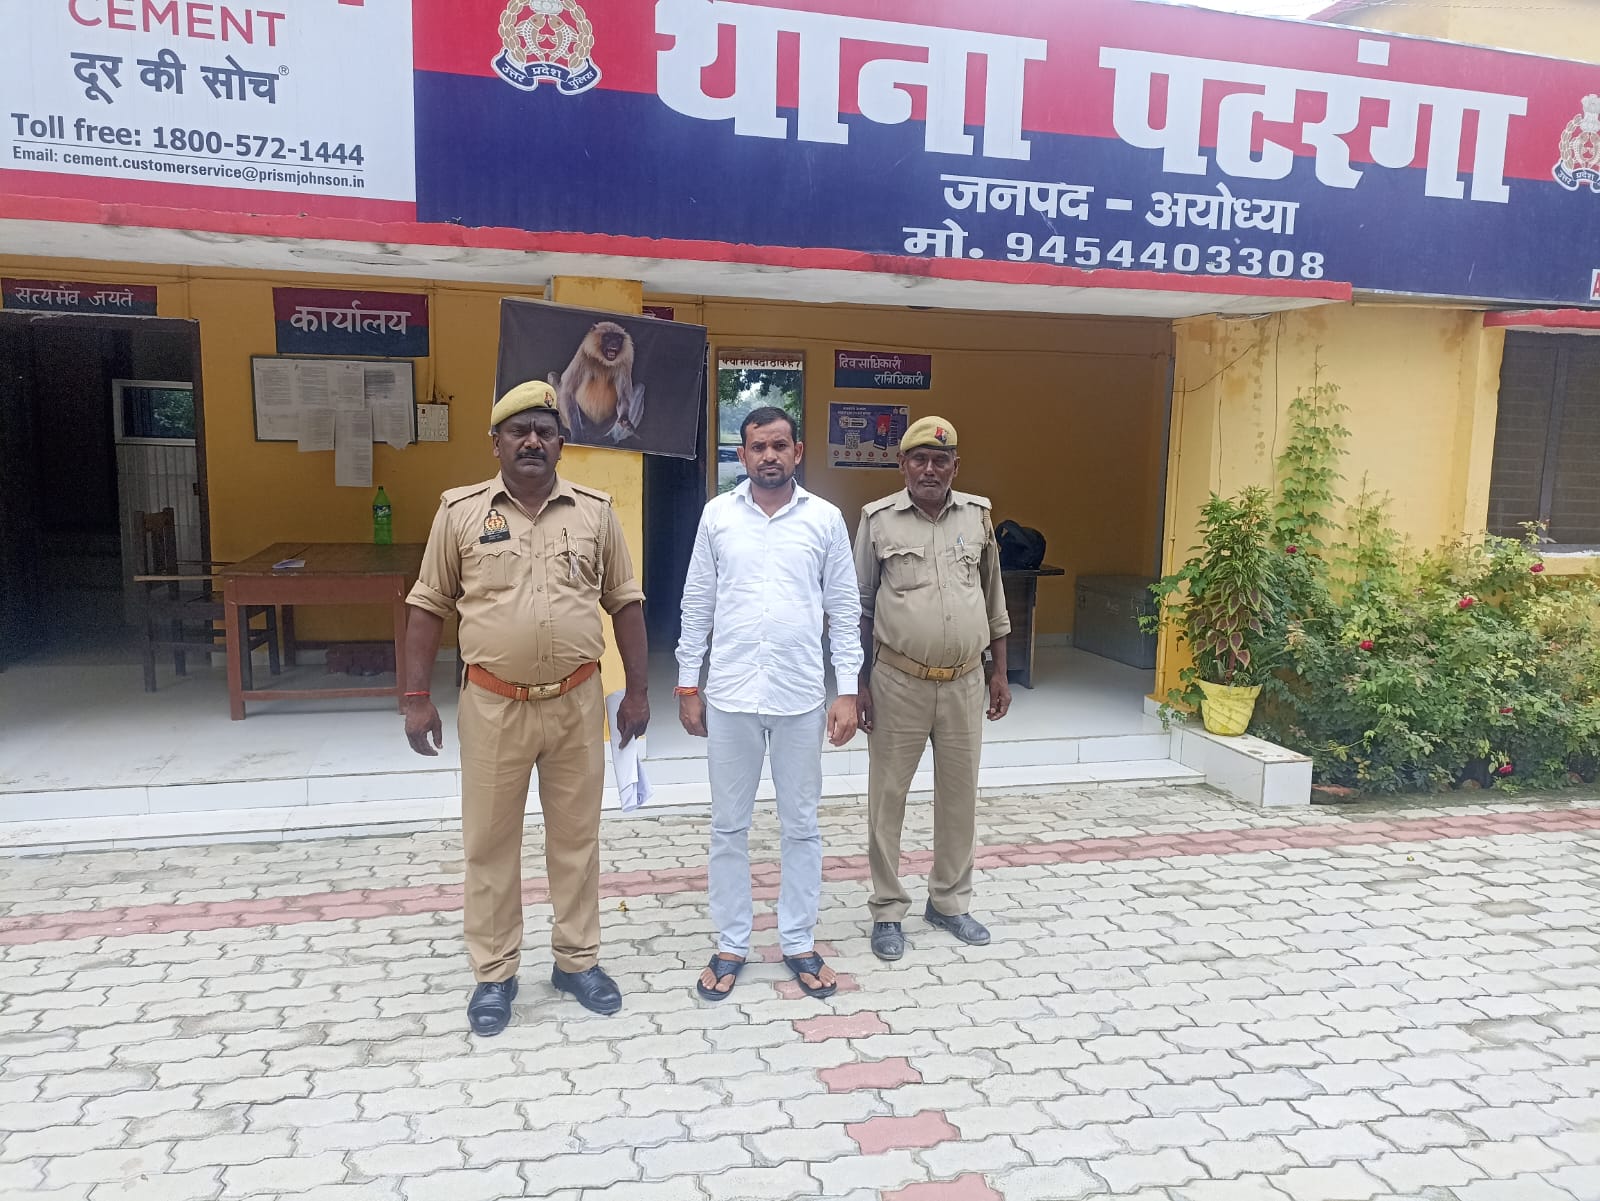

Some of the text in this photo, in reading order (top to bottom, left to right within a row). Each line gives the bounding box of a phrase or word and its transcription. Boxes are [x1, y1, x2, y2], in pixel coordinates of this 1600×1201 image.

[69, 0, 285, 47] CEMENT
[71, 51, 124, 104] दूर
[136, 48, 187, 95] की
[531, 64, 562, 78] प्रदेश
[655, 0, 1528, 204] थाना पटरंगा
[11, 112, 365, 166] Toll free: 1800-572-1444
[12, 145, 365, 188] Email: cement.customerservice@prismjohnson.in
[940, 174, 1095, 221] जनपद
[1145, 182, 1300, 235] अयोध्या
[902, 218, 1325, 280] मो. 9454403308
[15, 286, 134, 308] सत्यमेव जयते
[289, 299, 412, 335] कार्यालय
